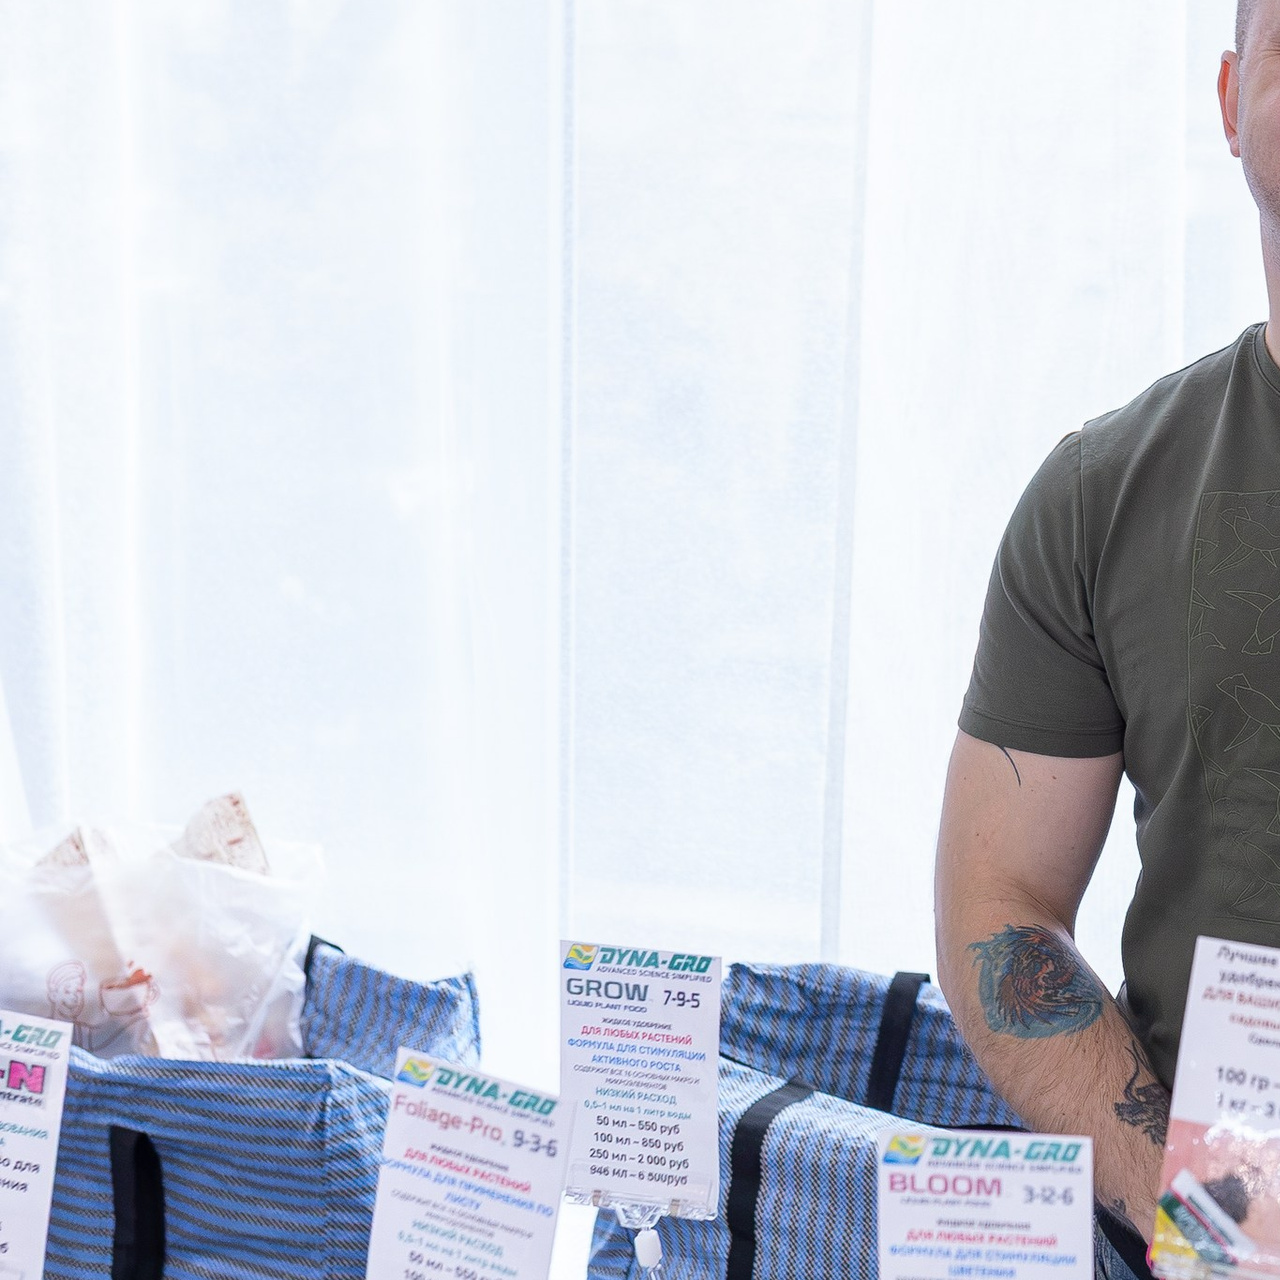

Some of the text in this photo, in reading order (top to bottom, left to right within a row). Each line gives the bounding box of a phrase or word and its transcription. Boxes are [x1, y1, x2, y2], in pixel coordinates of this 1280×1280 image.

[599, 947, 712, 973] DYNA-GRO
[596, 966, 712, 983] ADVANCED SCIENCE SIMPLIFIED
[567, 978, 700, 1008] GROW 7-9-5
[624, 1005, 647, 1013] FOOD
[0, 1023, 62, 1050] -GRO
[581, 1026, 692, 1045] ДЛЯ ЛЮБЫХ РАСТЕНИЙ
[568, 1039, 706, 1061] ФОРМУЛА ДЛЯ СТИМУЛЯЦИИ
[592, 1055, 681, 1071] АКТИВНОГО РОСТА
[1217, 1067, 1246, 1085] 100
[1250, 1075, 1270, 1091] гр
[436, 1068, 557, 1115] DYNA-GRO
[596, 1086, 636, 1099] НИЗКИЙ
[393, 1094, 503, 1142] Foliage-Pro
[513, 1129, 558, 1158] 9-3-6
[596, 1116, 680, 1135] 50 мл 550 руб
[594, 1132, 684, 1153] 100 мл 850 руб
[931, 1137, 1082, 1162] DYNA-GRO
[589, 1148, 609, 1159] 250
[612, 1153, 627, 1162] мл
[669, 1159, 689, 1170] руб
[613, 1169, 627, 1178] мл
[889, 1174, 1001, 1197] BLOOM
